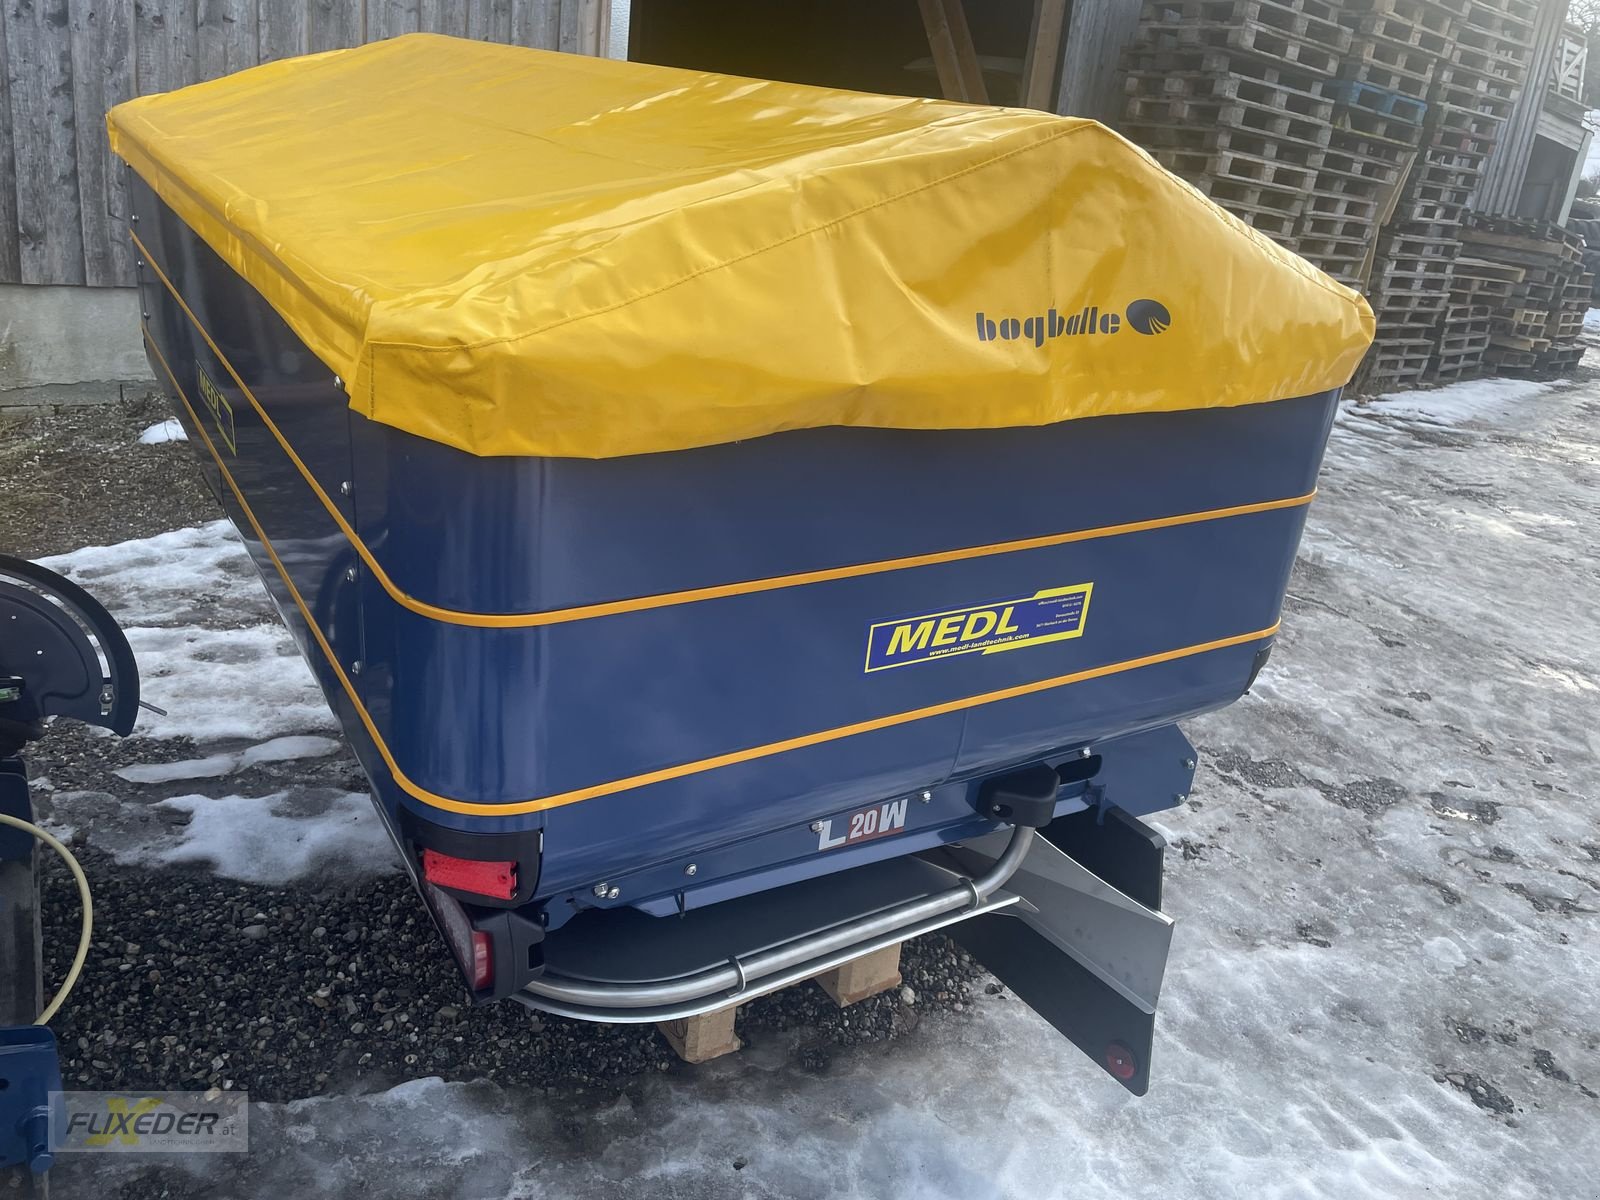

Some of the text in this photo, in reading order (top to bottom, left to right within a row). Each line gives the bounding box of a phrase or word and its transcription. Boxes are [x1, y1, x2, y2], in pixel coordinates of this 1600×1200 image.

[199, 367, 221, 420] MEDL
[886, 606, 1019, 656] MEDL
[929, 633, 1030, 656] www.medl-landtechnik.com
